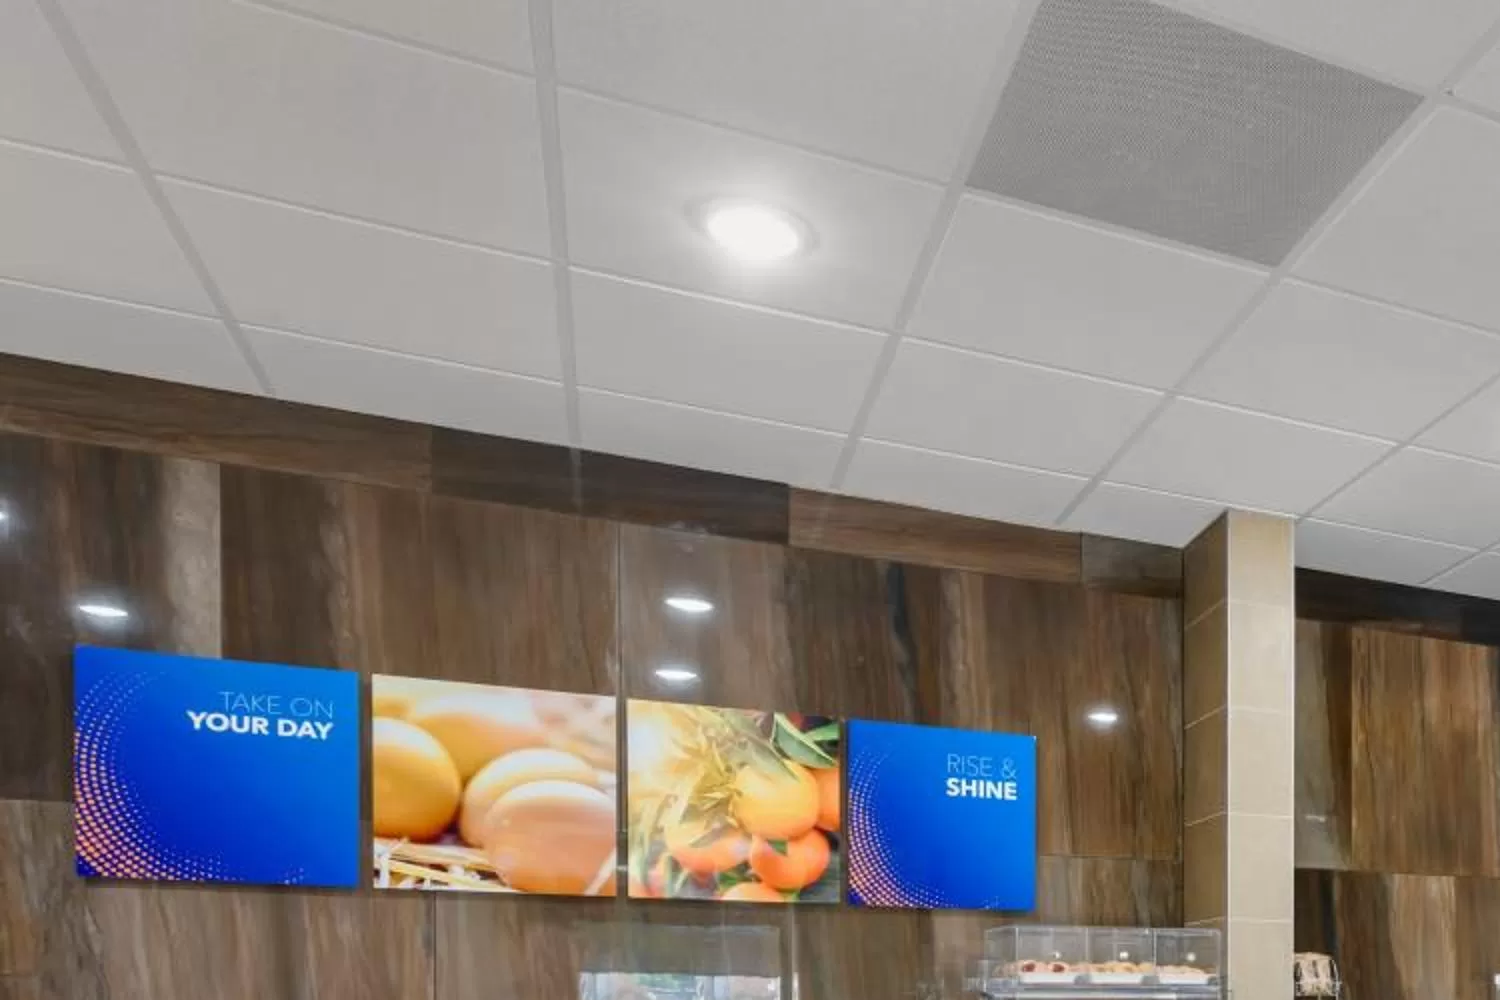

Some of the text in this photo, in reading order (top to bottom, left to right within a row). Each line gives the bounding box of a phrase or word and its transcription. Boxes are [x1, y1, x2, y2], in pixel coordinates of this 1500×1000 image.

[219, 691, 334, 719] TAKE ON
[186, 710, 334, 740] YOUR DAY
[947, 753, 1017, 779] RISE &
[946, 777, 1018, 800] SHINE
